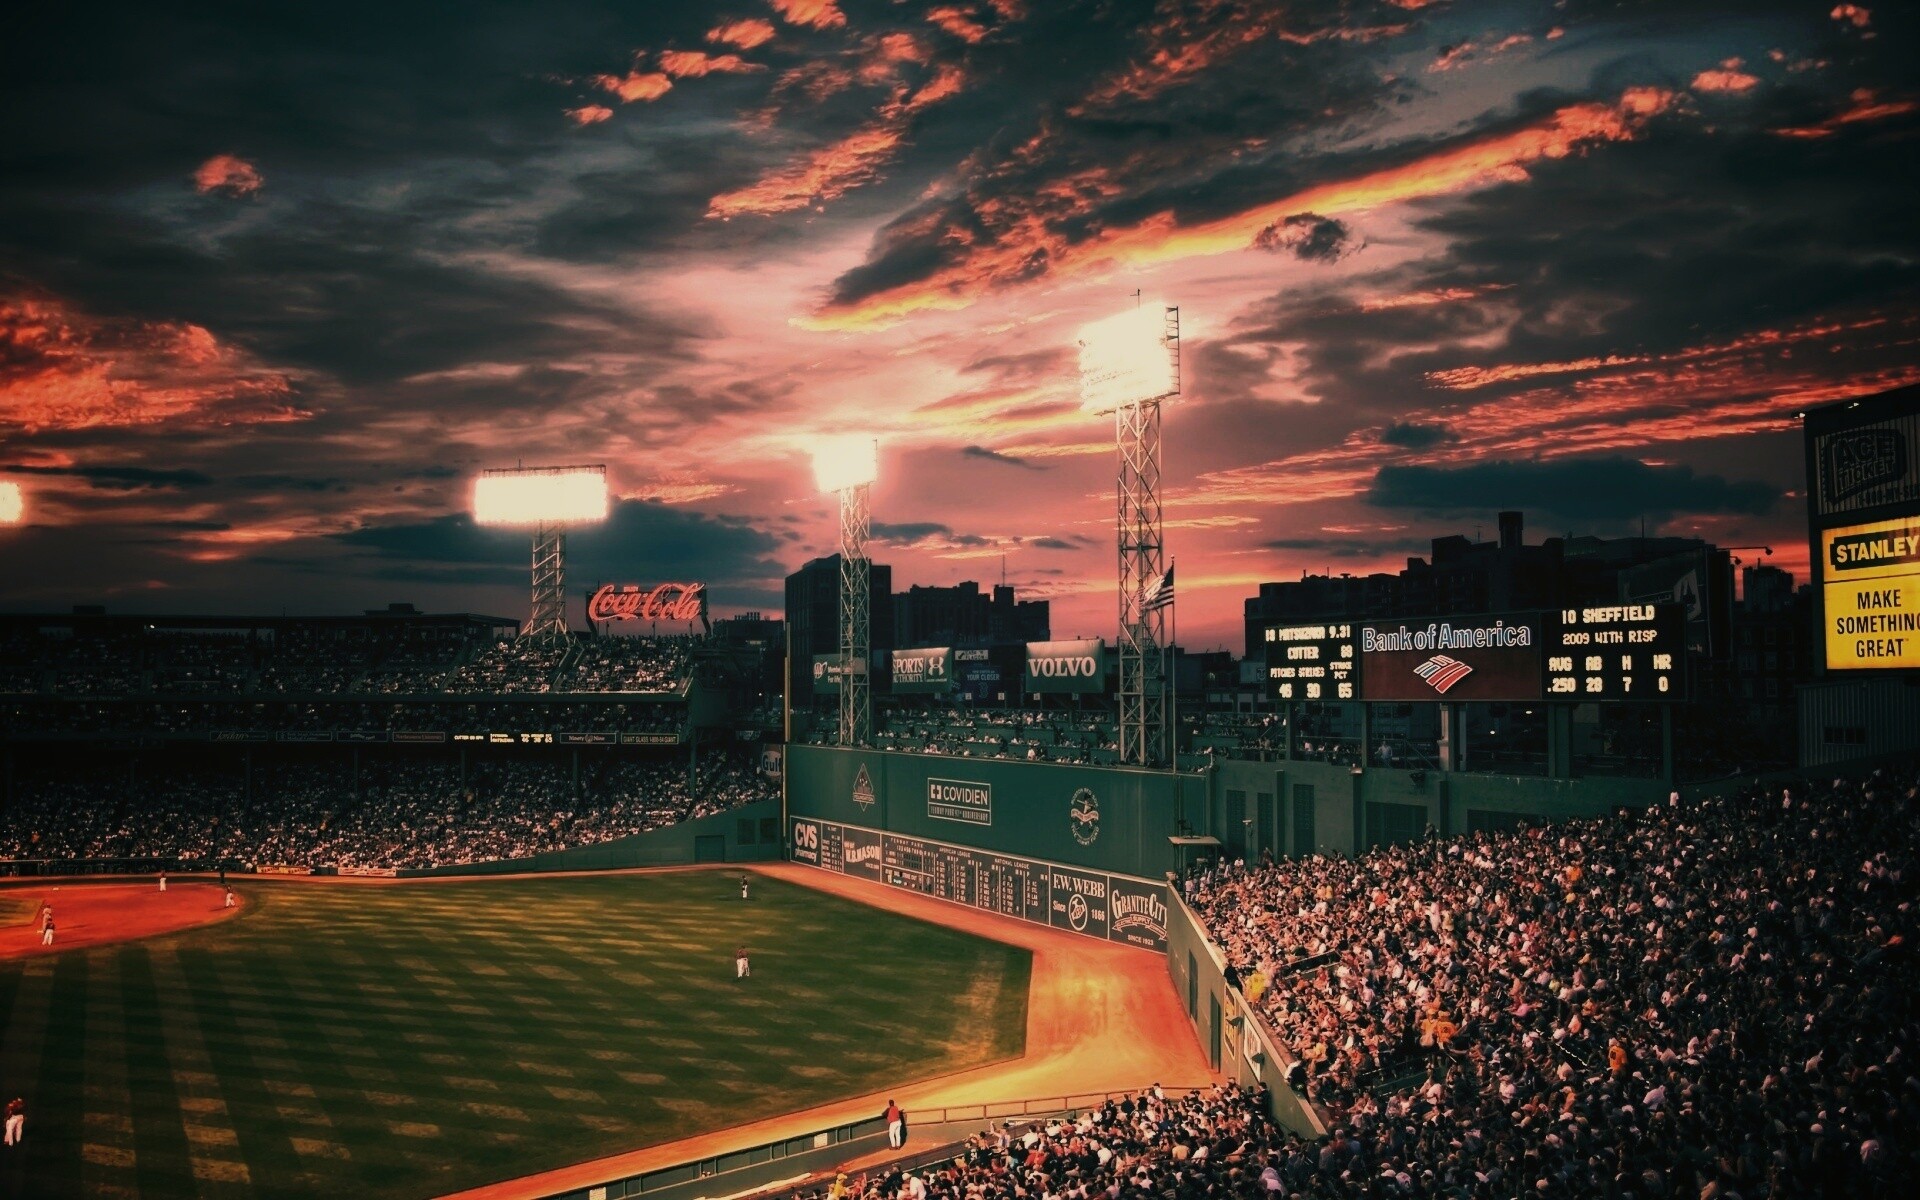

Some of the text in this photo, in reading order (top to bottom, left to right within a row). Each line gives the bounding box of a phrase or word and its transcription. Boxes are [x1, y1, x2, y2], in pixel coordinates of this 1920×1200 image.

[1836, 535, 1920, 563] STANLEY
[588, 582, 706, 621] Coca-Cola
[1857, 589, 1902, 610] MAKE
[1562, 605, 1655, 624] 10 SHEFFIELD
[1362, 620, 1531, 652] Bank of America
[1562, 629, 1658, 645] 2009 WITH RISP
[1856, 638, 1903, 658] GREAT
[893, 657, 924, 674] SPORTS
[1028, 656, 1096, 677] VOLVO
[1548, 653, 1672, 672] AVG AB H HR
[1547, 676, 1668, 693] .250 28 7 0
[943, 786, 988, 805] COVIDIEN
[795, 822, 817, 849] CVS
[795, 847, 818, 862] pharmacy
[1072, 877, 1105, 898] WEBB
[1053, 900, 1066, 913] Since
[1112, 889, 1149, 919] GRANITE
[1132, 915, 1151, 925] SUPPLY
[1128, 934, 1141, 943] SINCE
